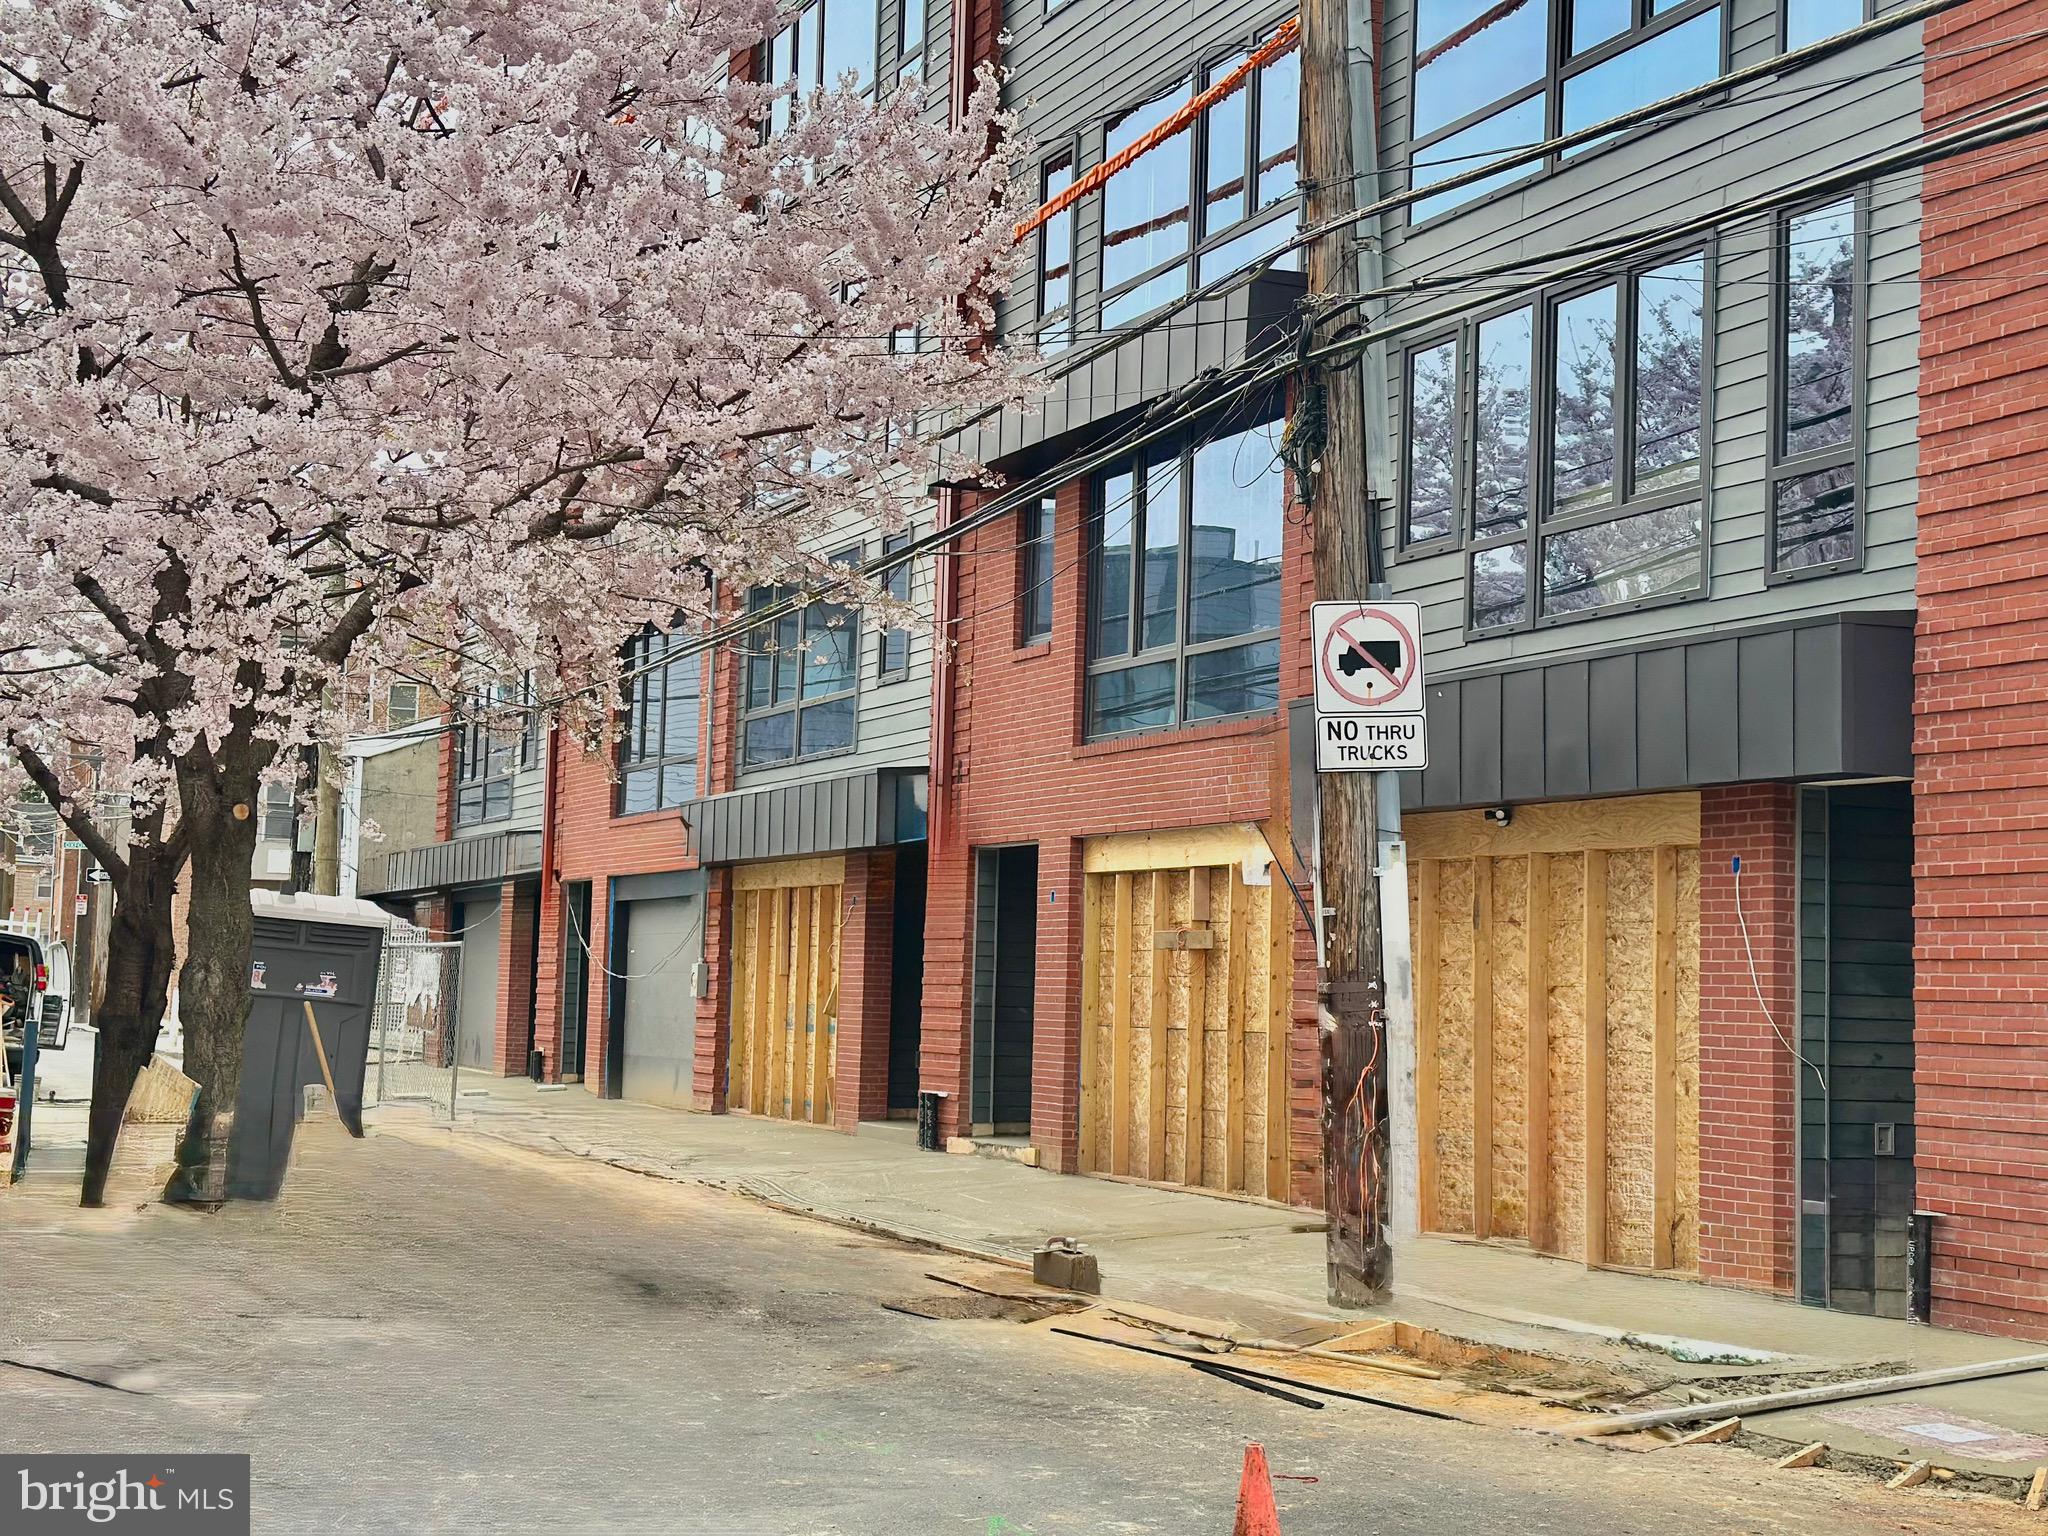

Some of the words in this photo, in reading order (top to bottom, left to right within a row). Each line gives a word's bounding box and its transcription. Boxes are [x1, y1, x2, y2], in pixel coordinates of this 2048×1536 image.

[1327, 720, 1358, 741] NO
[1365, 724, 1415, 741] THRU
[1337, 744, 1408, 761] TRUCKS
